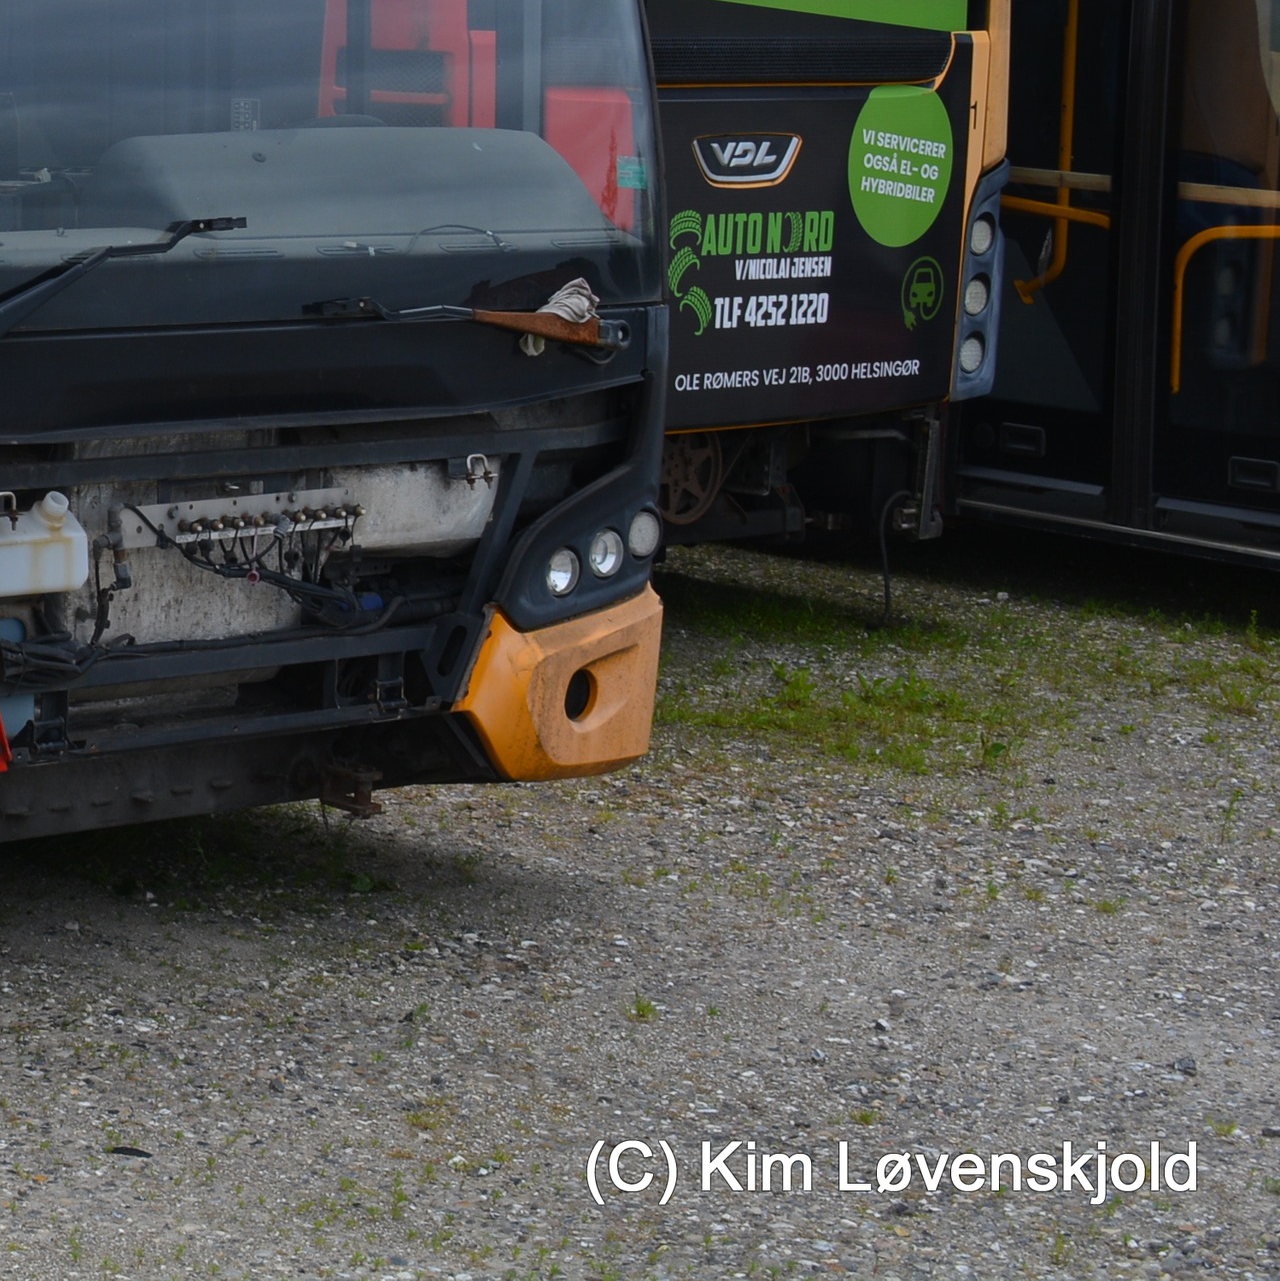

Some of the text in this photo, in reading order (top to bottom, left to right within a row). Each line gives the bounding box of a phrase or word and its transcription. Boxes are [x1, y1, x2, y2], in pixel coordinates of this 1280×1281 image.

[710, 141, 778, 168] VDL
[863, 128, 946, 159] VI SERVICERER
[863, 152, 939, 180] OGSÅ EL- OG
[861, 176, 936, 203] HYBRIDBILER
[701, 213, 763, 256] AUTO
[790, 256, 832, 279] JENSEN
[714, 292, 829, 329] TLF 4252 1220
[674, 359, 920, 391] OLE RØMERS VEJ 21B, 3000 HELSINGØR
